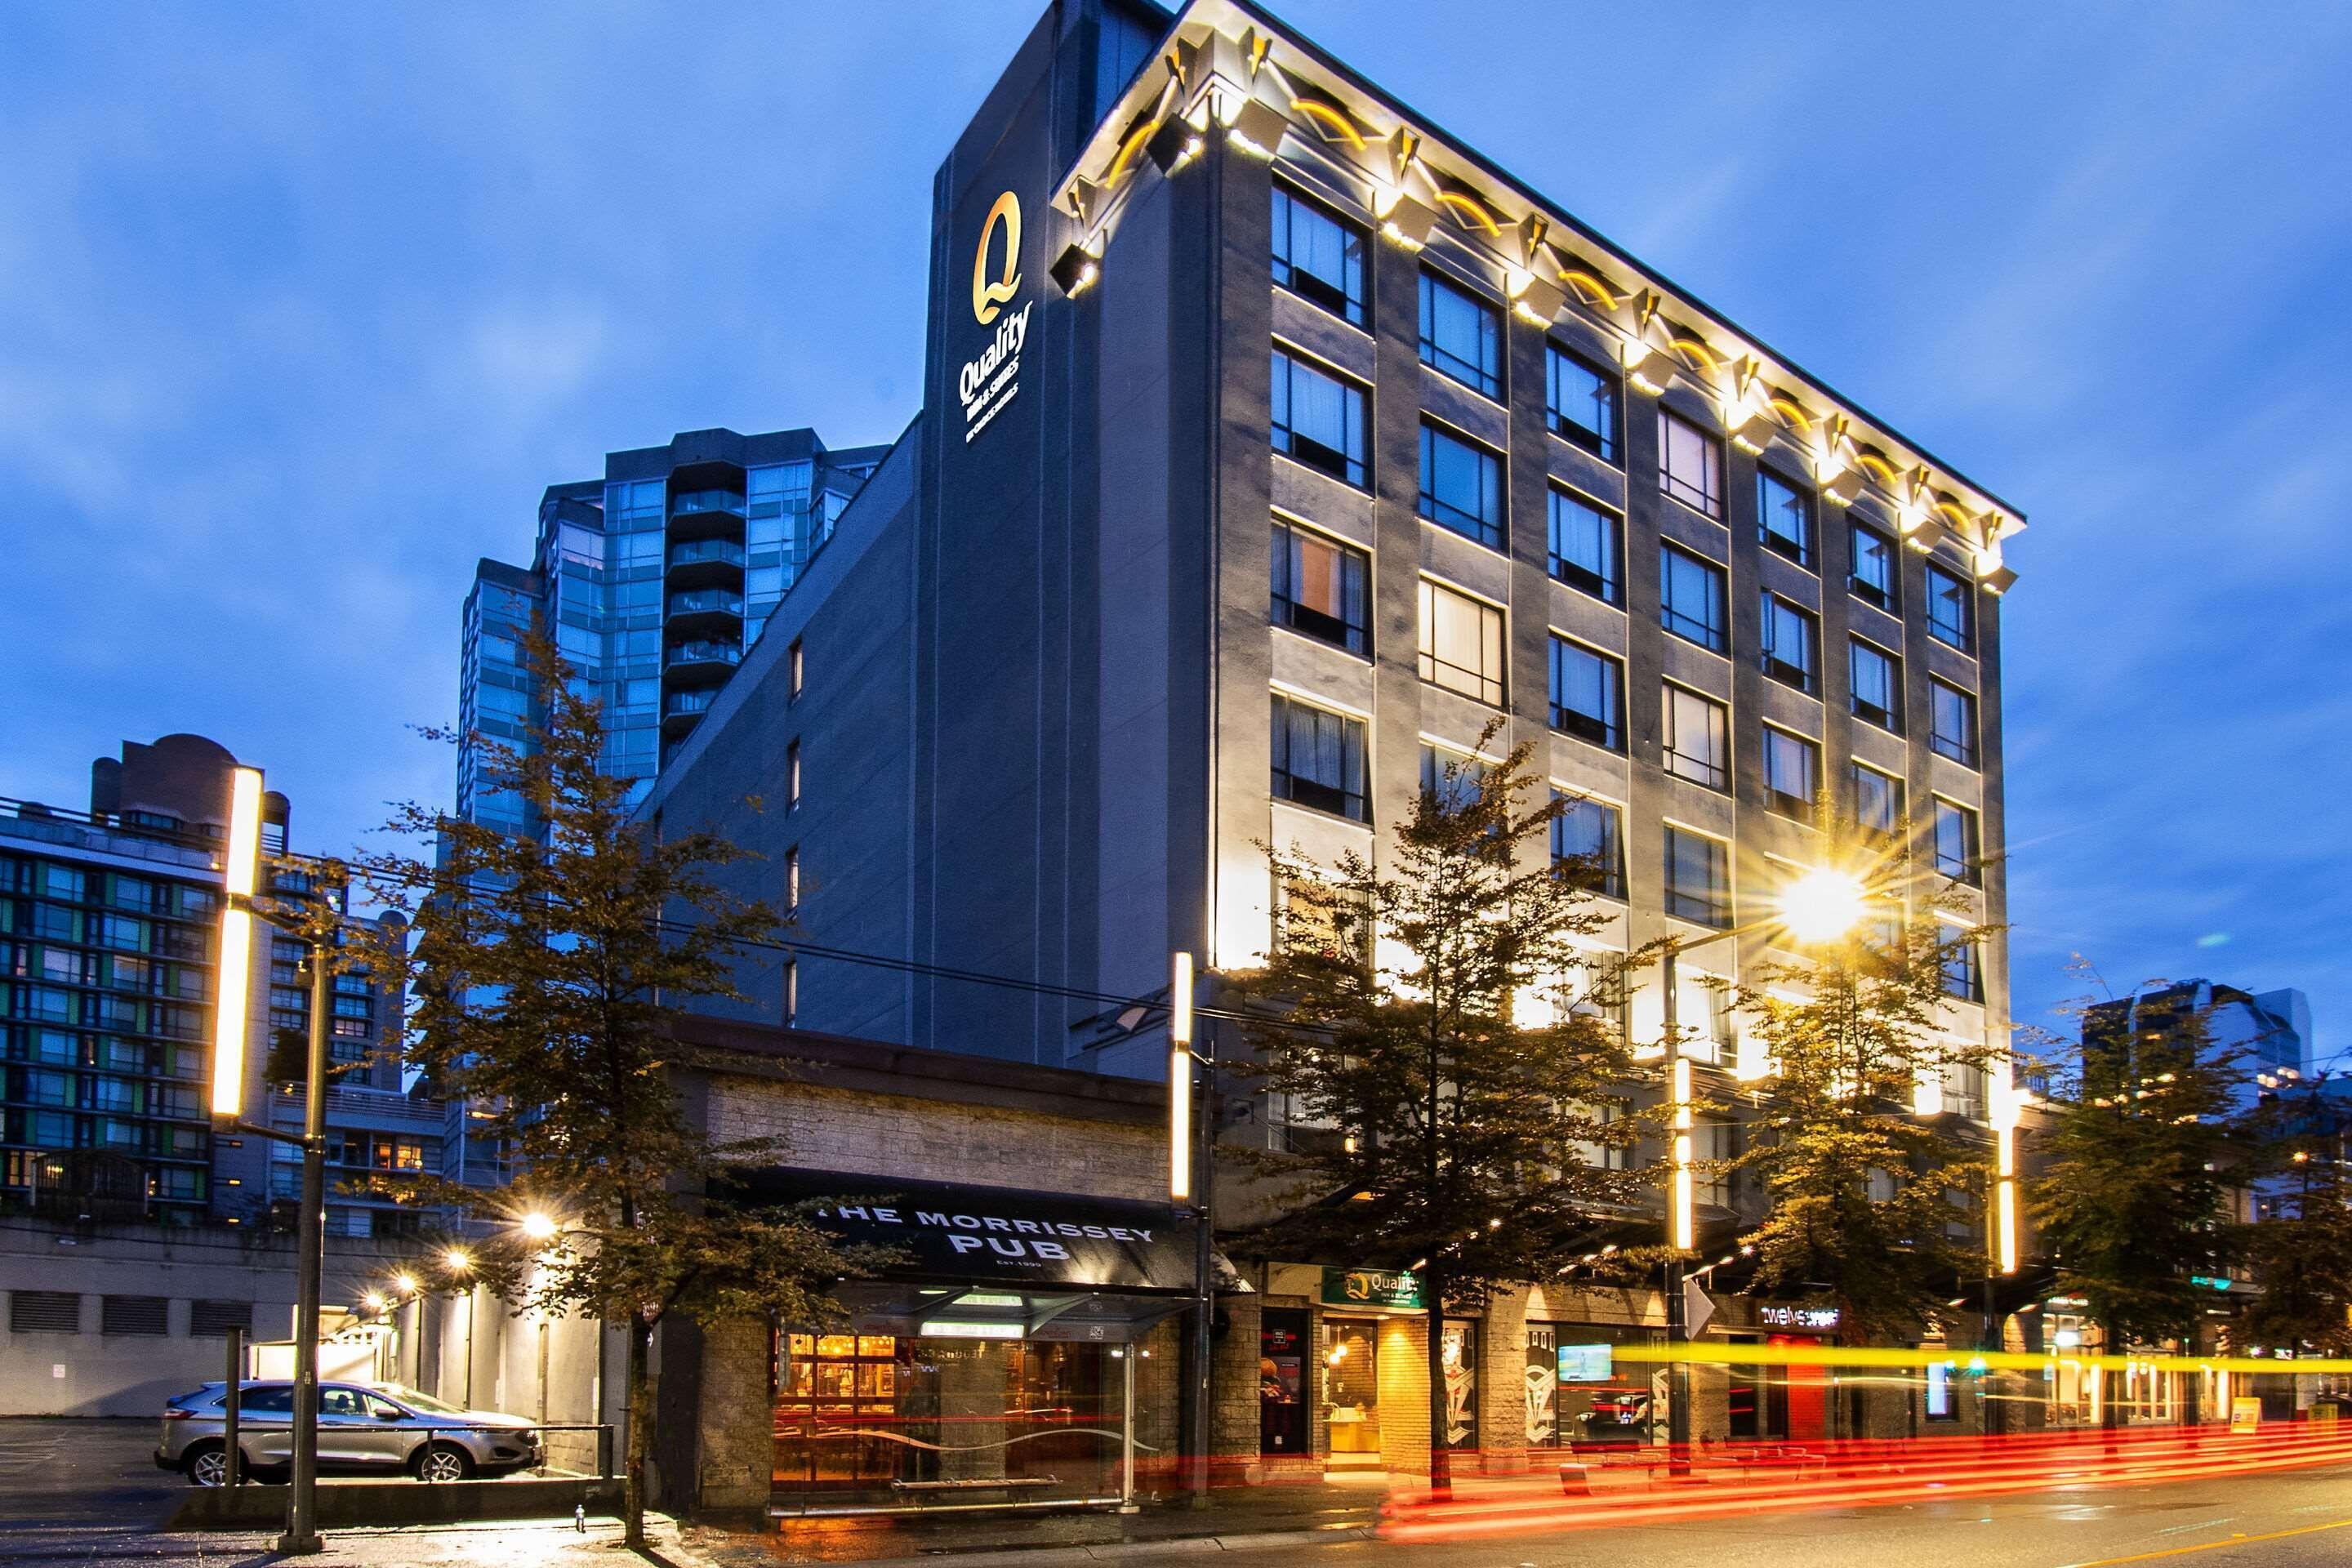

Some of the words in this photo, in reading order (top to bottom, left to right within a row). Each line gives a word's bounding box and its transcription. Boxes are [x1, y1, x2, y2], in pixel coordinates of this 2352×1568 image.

[959, 301, 1033, 406] Quality
[817, 1205, 903, 1223] HE
[915, 1211, 1154, 1242] MORRISSEY
[947, 1234, 1070, 1260] PUB
